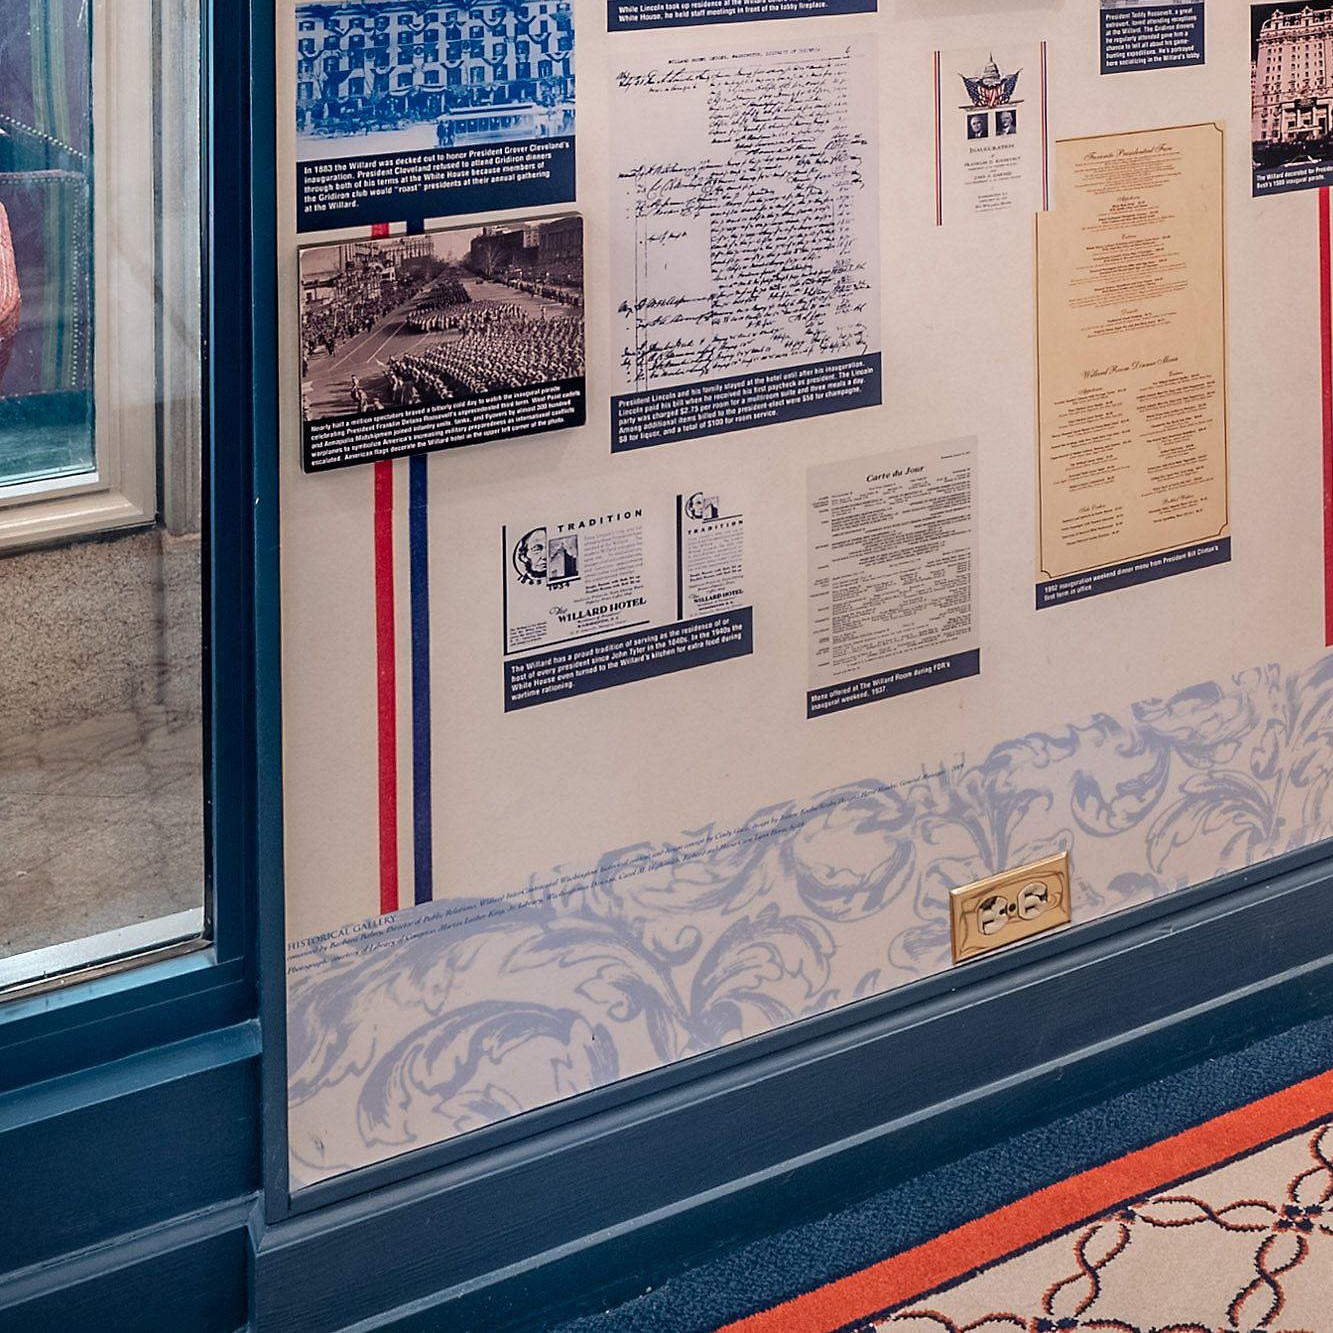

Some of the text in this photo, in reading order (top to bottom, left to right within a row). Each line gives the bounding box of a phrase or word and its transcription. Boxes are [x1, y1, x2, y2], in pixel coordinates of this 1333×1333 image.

[866, 465, 925, 483] Carte du Jour
[557, 509, 643, 533] TRADITION
[688, 520, 743, 535] TRADITION
[558, 604, 608, 623] WILLARD
[609, 597, 647, 614] HOTEL
